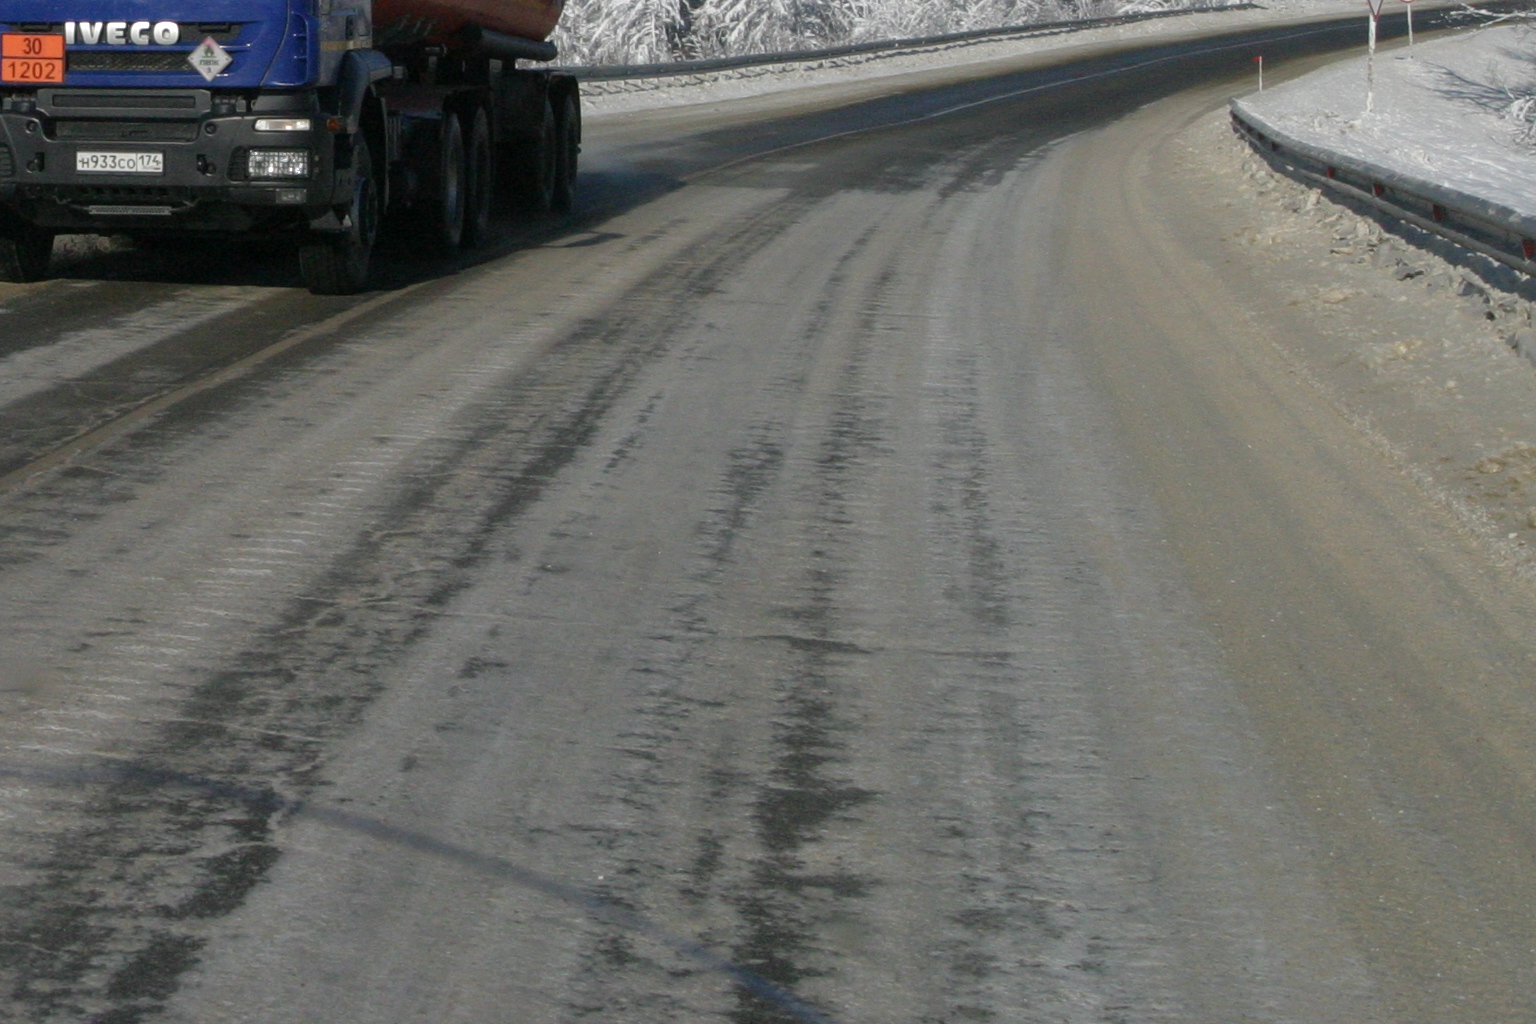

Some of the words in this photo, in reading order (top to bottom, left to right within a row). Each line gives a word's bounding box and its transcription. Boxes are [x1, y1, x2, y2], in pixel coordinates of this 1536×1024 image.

[64, 21, 180, 45] IVECO
[22, 37, 42, 55] 30
[8, 62, 56, 80] 1202
